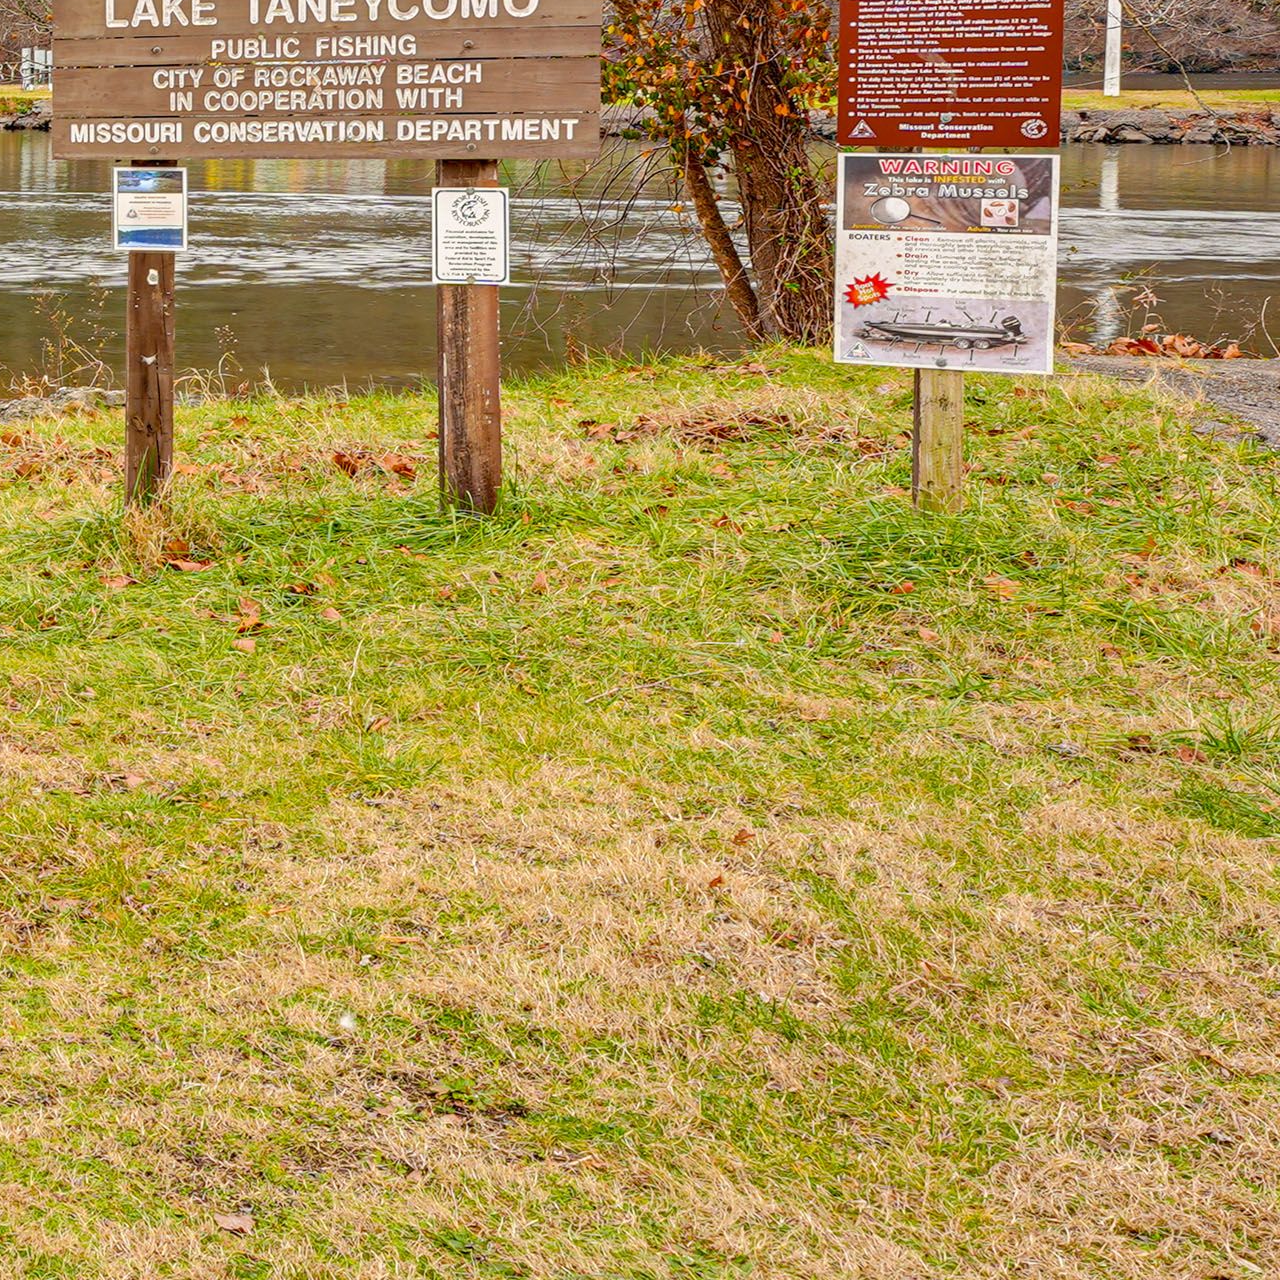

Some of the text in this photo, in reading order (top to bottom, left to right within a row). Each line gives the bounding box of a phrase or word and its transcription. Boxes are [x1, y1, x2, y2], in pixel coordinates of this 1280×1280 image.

[211, 34, 417, 60] PUBLIC FISHING
[152, 63, 482, 90] CITY OF ROCKAWAY BEACH
[169, 88, 463, 112] IN COOPERATION WITH
[70, 118, 579, 145] MISSOURI CONSERVATION DEPARTMENT
[899, 123, 993, 131] Missouri Conservation
[921, 131, 970, 140] Department
[878, 159, 1016, 175] WARNING
[934, 175, 986, 184] INFESTED
[864, 183, 1029, 199] Zebra Mussels
